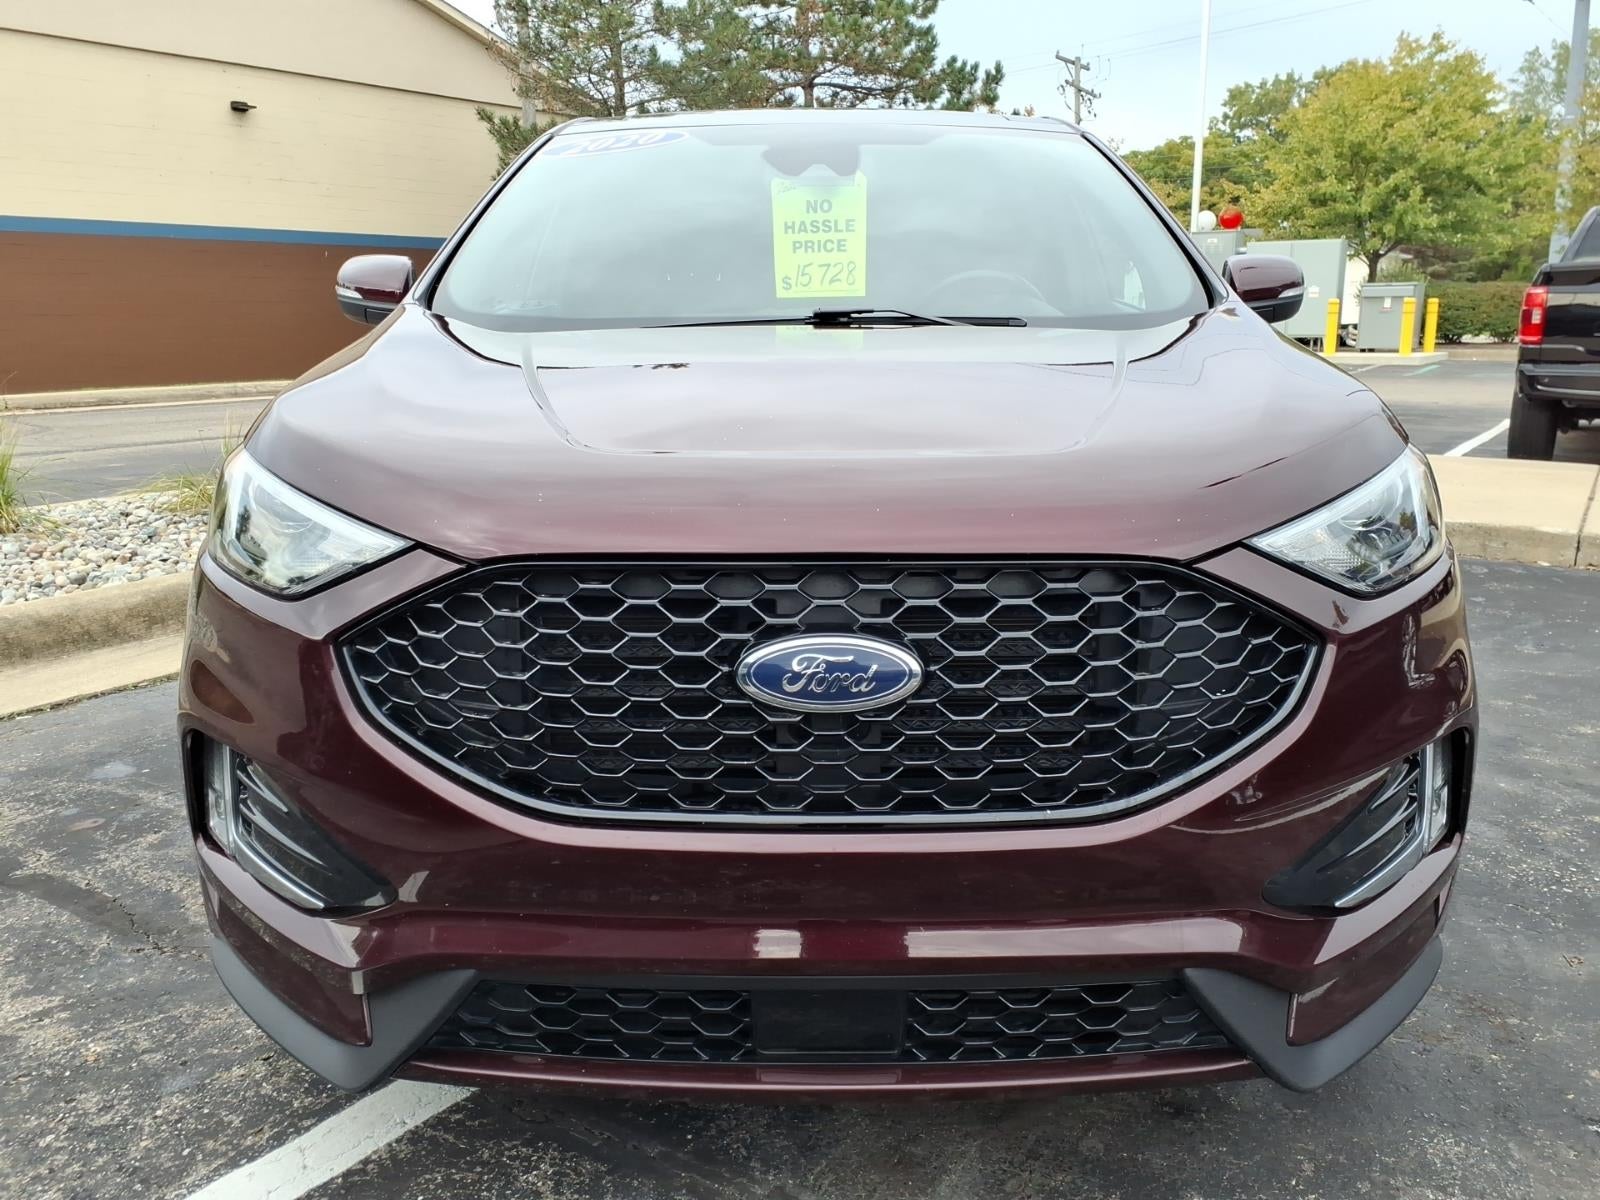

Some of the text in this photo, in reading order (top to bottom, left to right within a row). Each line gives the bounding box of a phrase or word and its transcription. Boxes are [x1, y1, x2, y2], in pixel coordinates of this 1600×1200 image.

[806, 199, 833, 214] NO
[784, 219, 856, 234] HASSLE
[792, 239, 848, 254] PRICE
[782, 653, 878, 693] Ford
